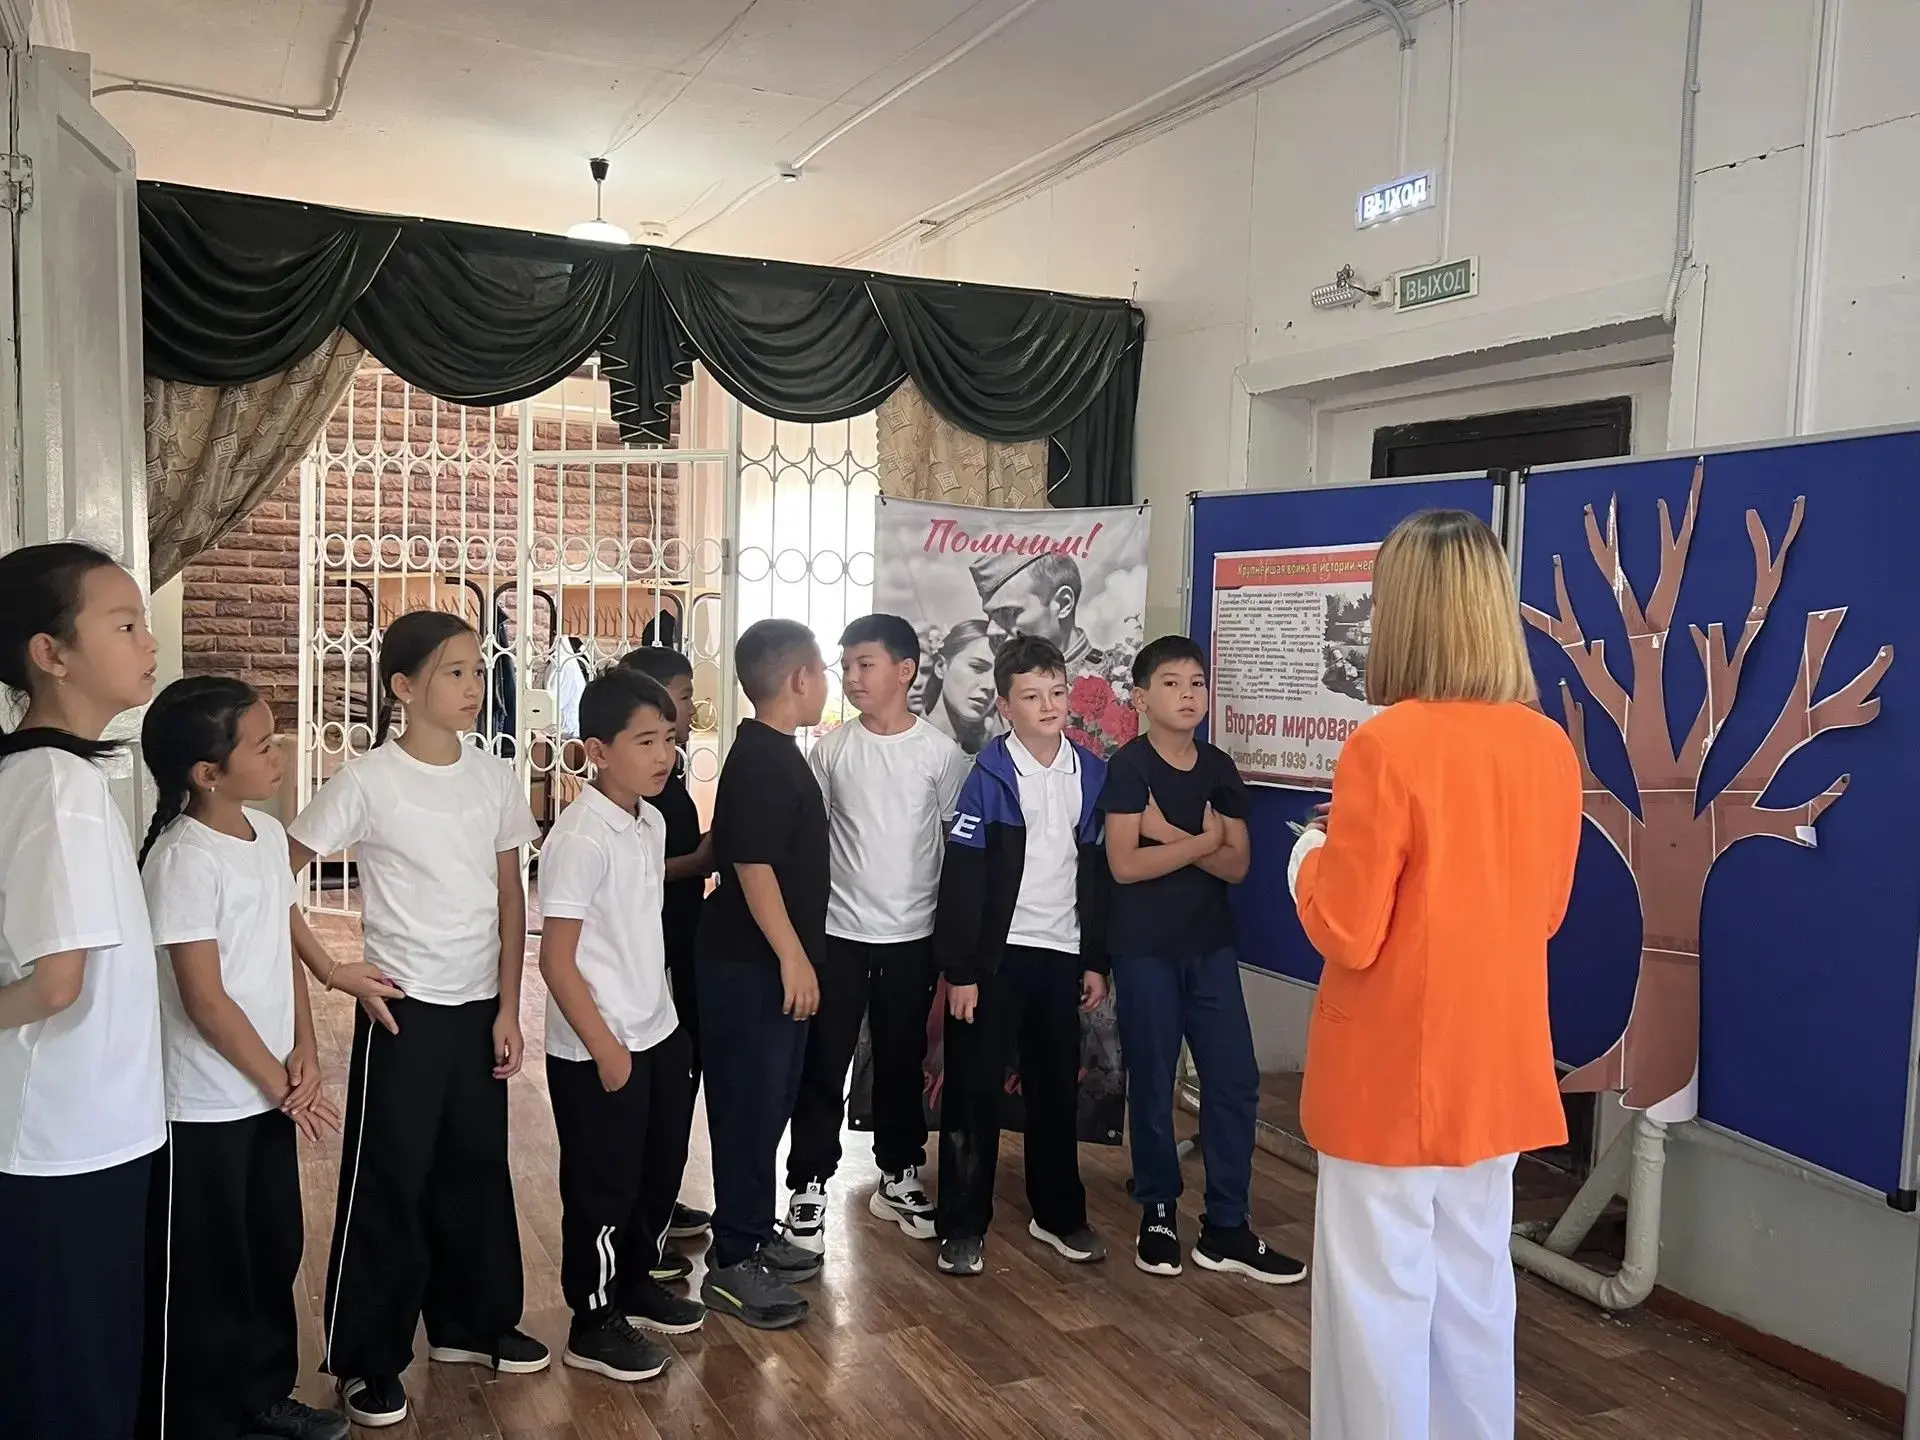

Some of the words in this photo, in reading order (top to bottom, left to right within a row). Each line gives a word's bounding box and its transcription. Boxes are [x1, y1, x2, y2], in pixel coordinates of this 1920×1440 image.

[1363, 177, 1427, 220] ВЫХОД
[1406, 267, 1466, 302] ВЫХОД
[922, 518, 1103, 559] Помним!
[1320, 562, 1355, 574] истории
[1225, 704, 1278, 743] Вторая
[1282, 715, 1359, 747] мировая
[1280, 750, 1307, 770] 1939
[1316, 753, 1323, 770] 3
[1148, 1224, 1177, 1240] adidas
